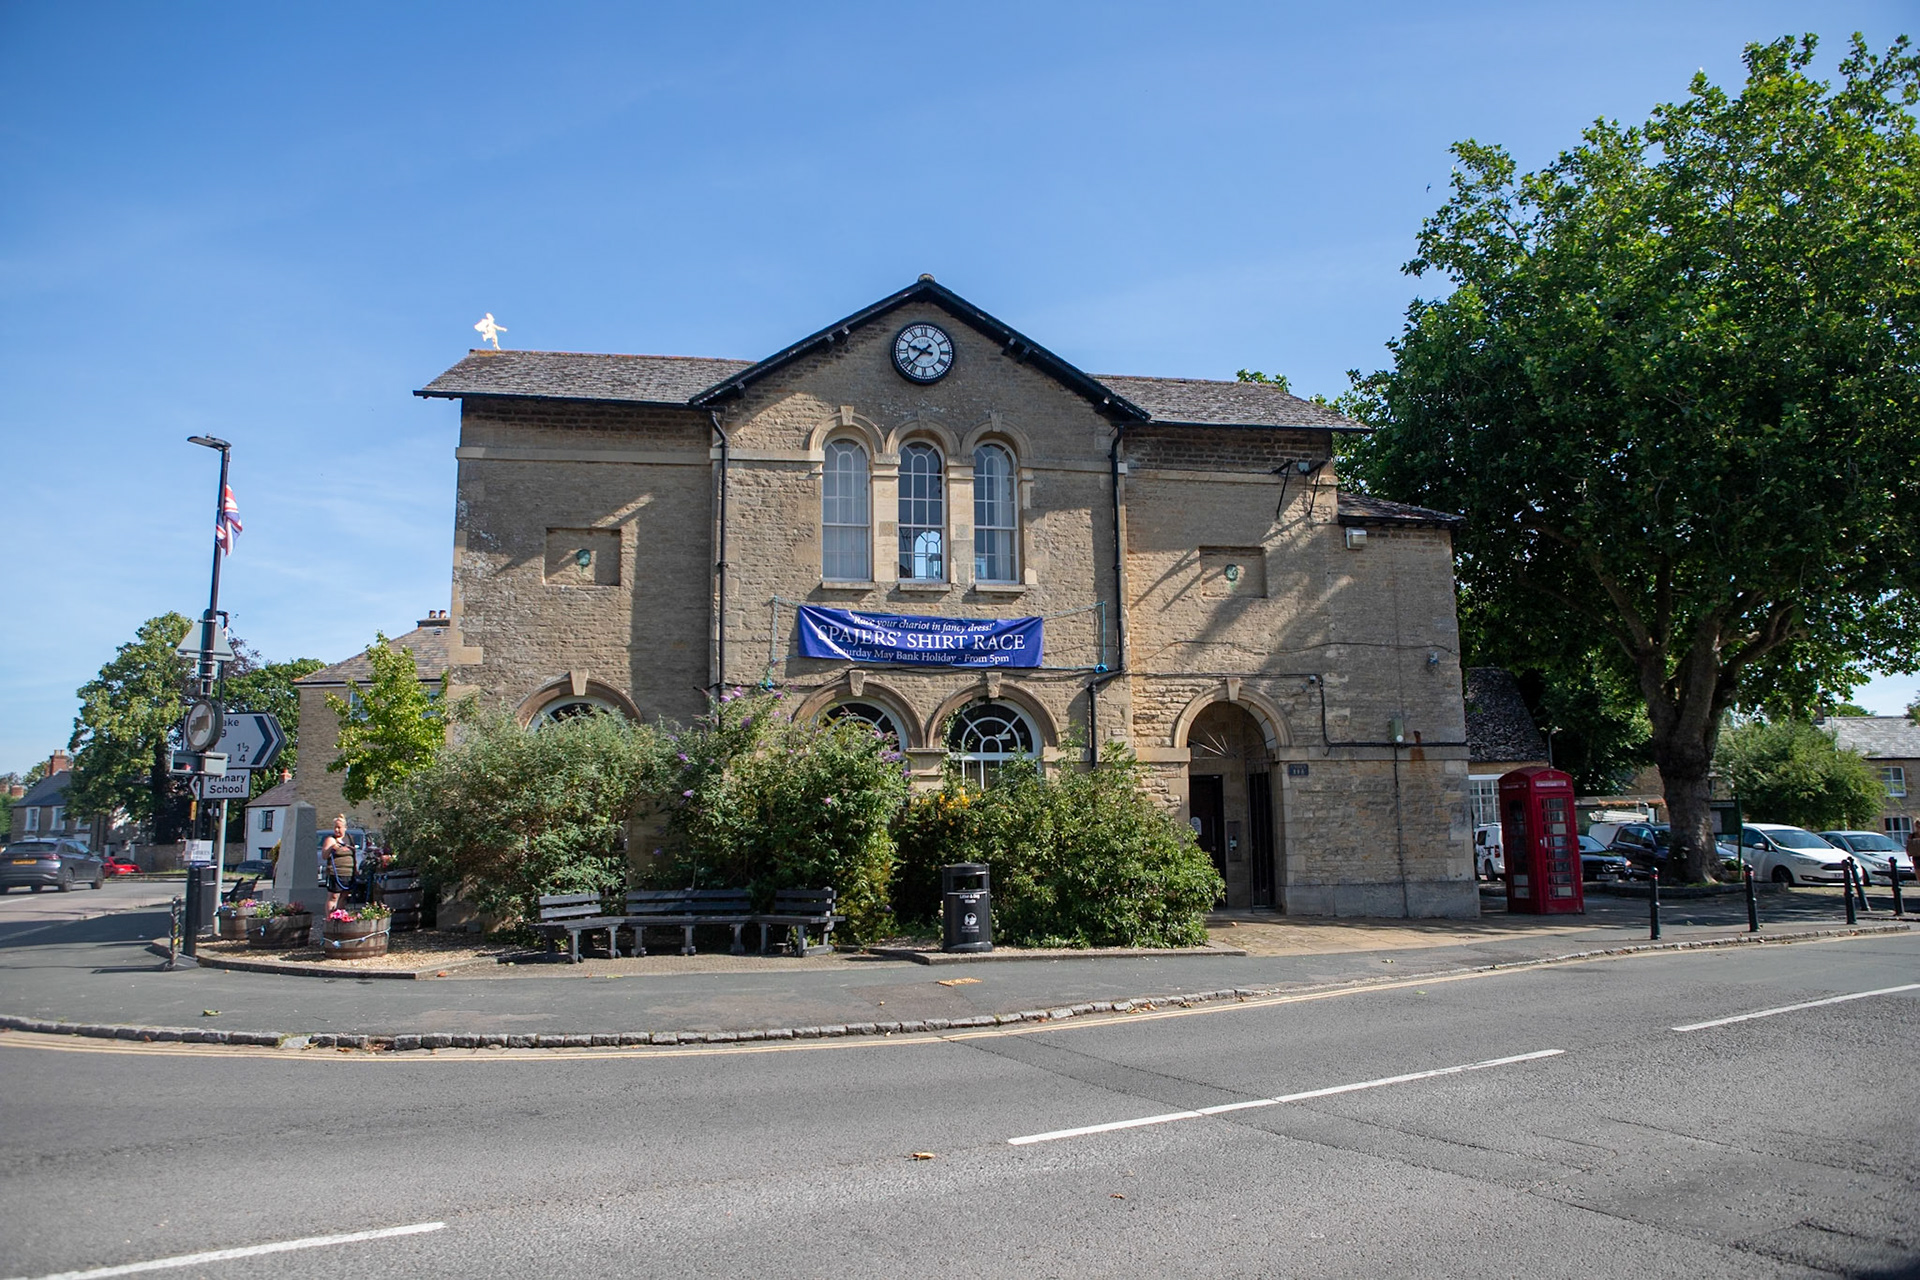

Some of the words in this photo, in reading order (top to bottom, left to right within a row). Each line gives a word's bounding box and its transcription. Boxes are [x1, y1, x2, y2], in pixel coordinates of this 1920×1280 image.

[875, 620, 897, 628] your
[899, 619, 930, 630] chariot
[931, 622, 941, 631] in
[941, 622, 966, 634] fancy
[906, 632, 968, 650] SHIRT
[972, 634, 1026, 651] RACE
[874, 649, 894, 660] May
[896, 651, 919, 661] Bank
[921, 651, 956, 663] Holiday
[964, 653, 988, 663] From
[989, 654, 1010, 665] 5pm
[238, 754, 246, 763] 4
[209, 784, 243, 794] School
